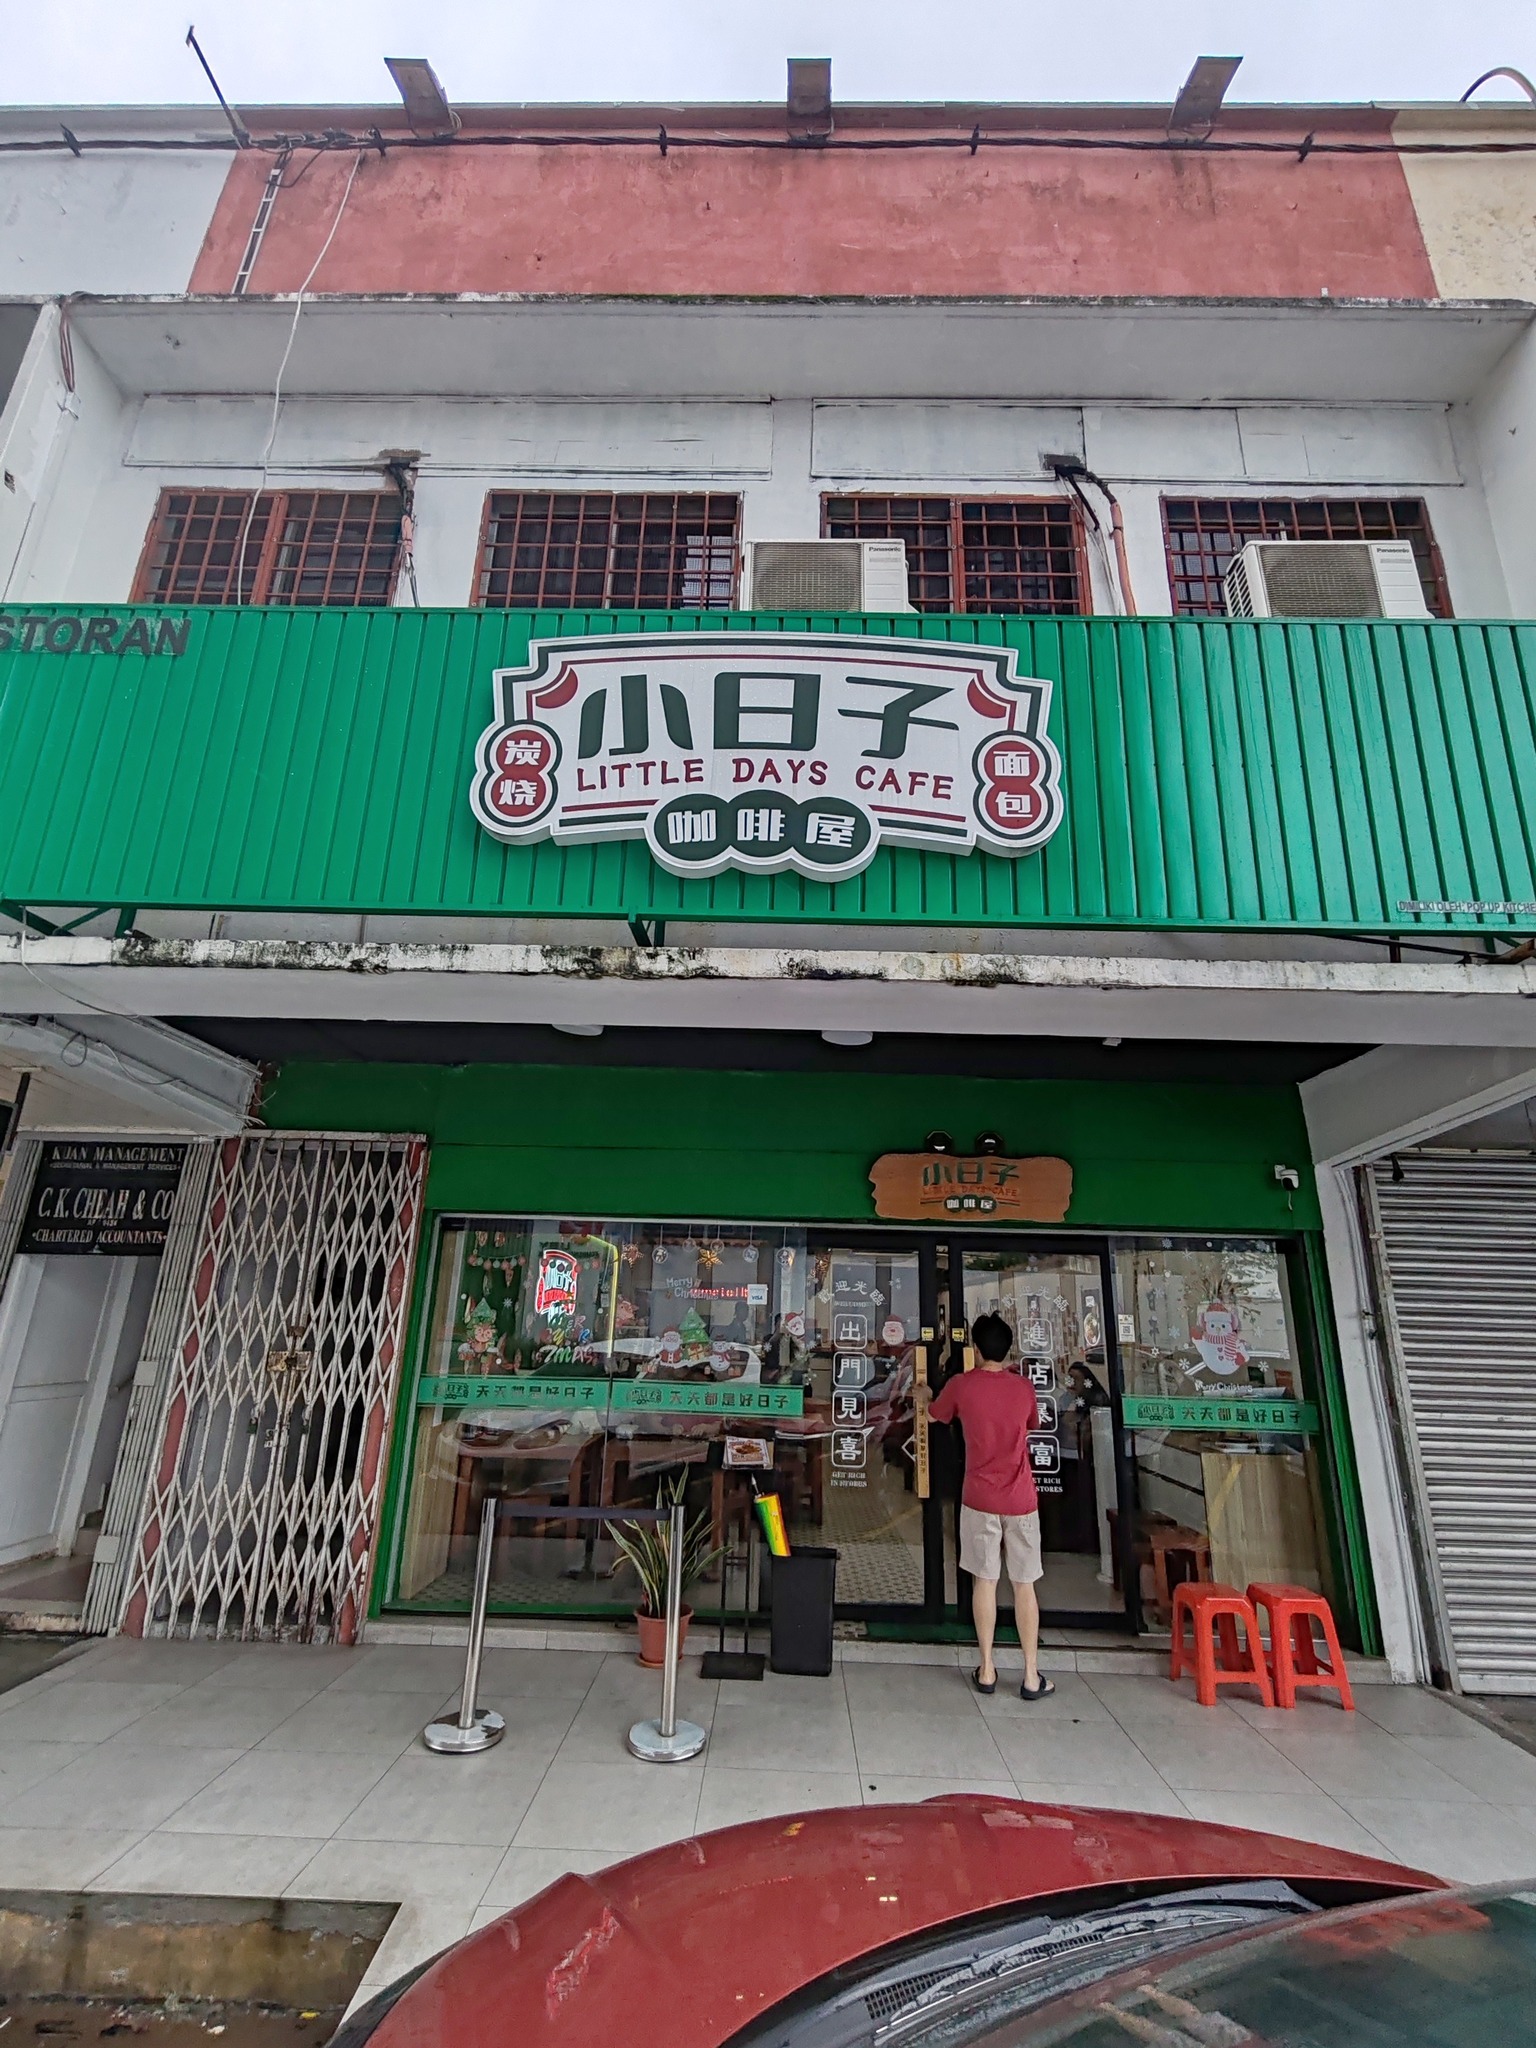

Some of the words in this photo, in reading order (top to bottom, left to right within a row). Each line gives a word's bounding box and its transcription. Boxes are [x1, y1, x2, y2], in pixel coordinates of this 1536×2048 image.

[577, 671, 960, 760] 小日子
[577, 758, 704, 792] LITTLE
[732, 757, 828, 786] DAYS
[855, 764, 954, 800] CAFE
[993, 750, 1033, 818] 面包
[667, 808, 856, 848] 咖啡屋
[1467, 902, 1486, 912] POP
[1488, 902, 1501, 912] UP
[93, 1146, 186, 1162] MANAGEMENT
[923, 1162, 1019, 1186] 小日子
[132, 1190, 146, 1220] &
[35, 1229, 93, 1243] CHARTERED
[96, 1230, 163, 1244] ACCOUNTANTS
[666, 1277, 692, 1288] Merry
[669, 1390, 788, 1409] 天天都是好日子
[835, 1320, 862, 1461] 出門見喜
[1182, 1407, 1301, 1424] 天天都是好日子
[1043, 1477, 1061, 1485] RICH
